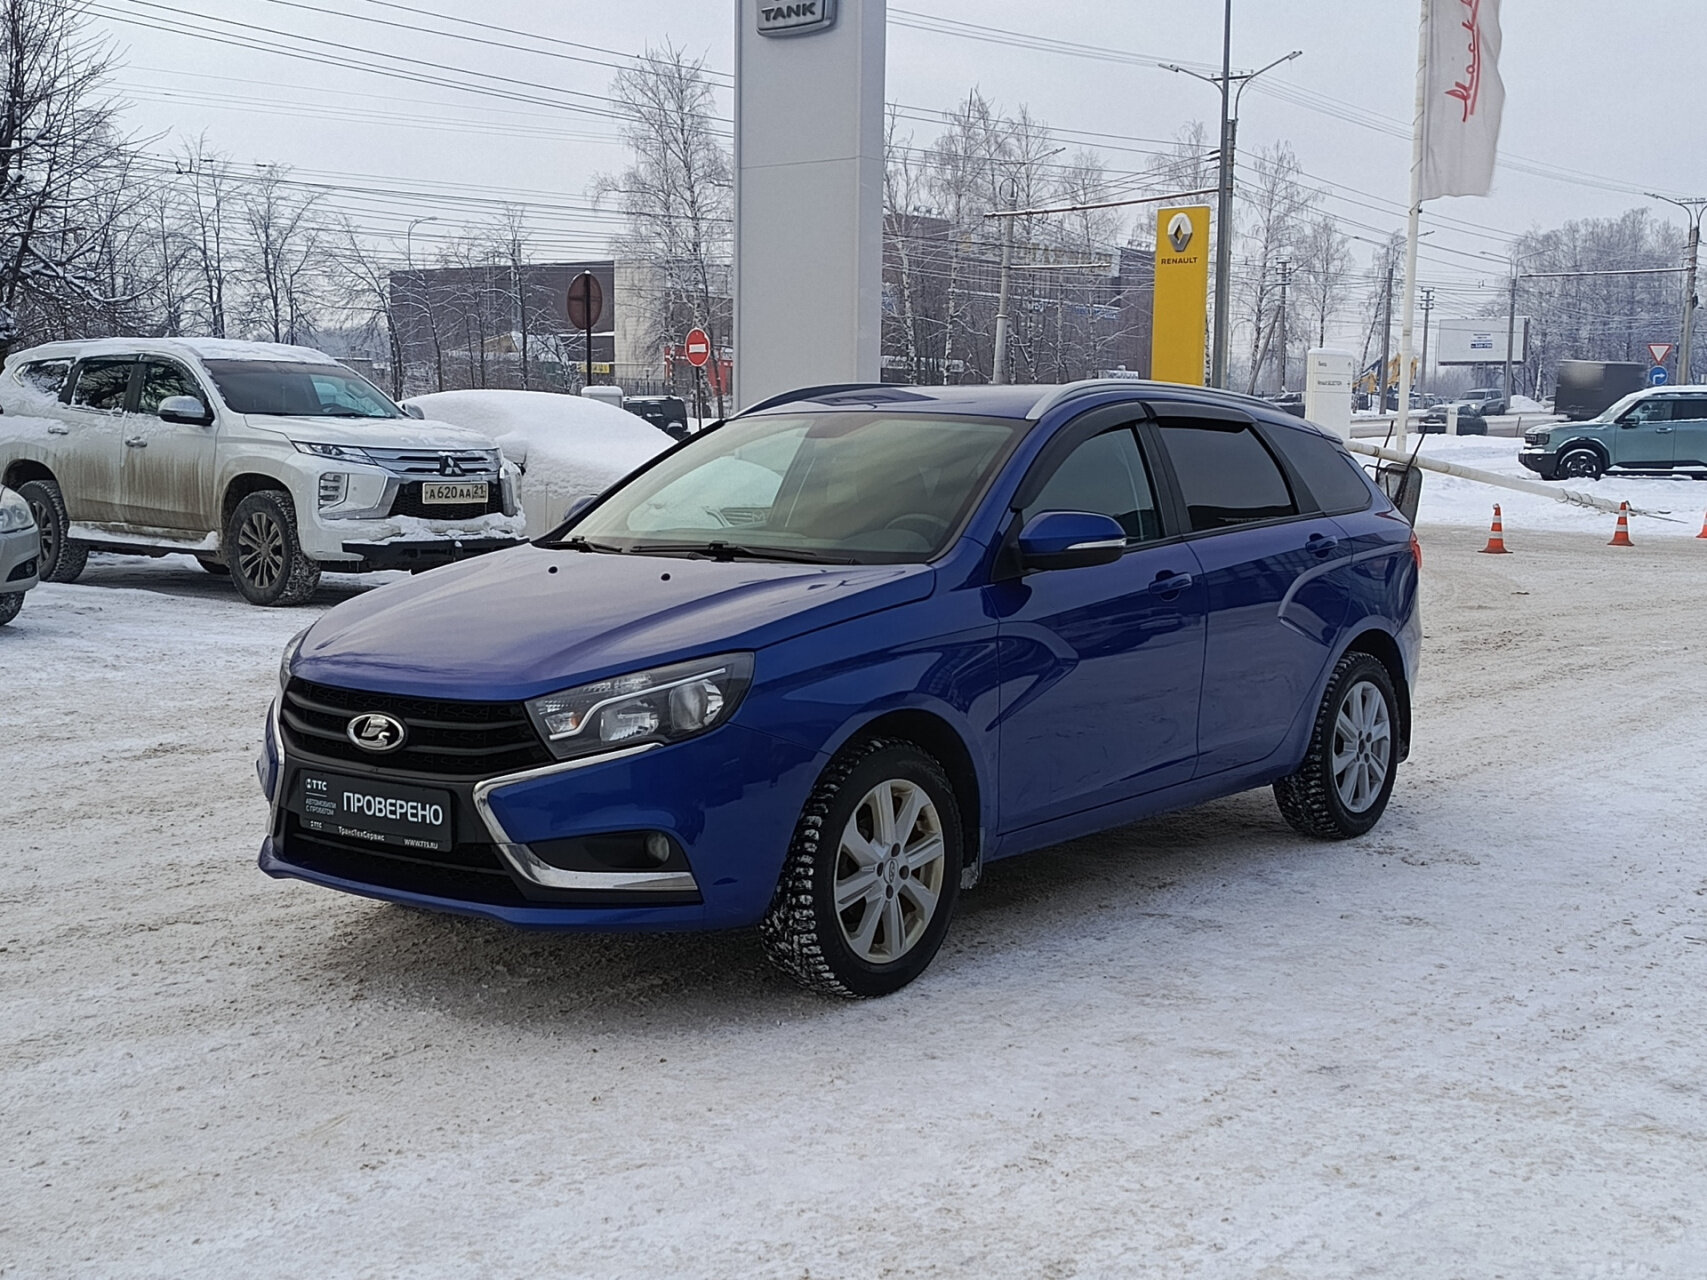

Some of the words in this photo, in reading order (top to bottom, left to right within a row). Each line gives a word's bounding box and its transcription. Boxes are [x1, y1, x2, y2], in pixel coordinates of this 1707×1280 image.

[761, 2, 816, 22] TANK
[1160, 256, 1198, 265] RENAULT
[343, 791, 443, 826] ПРОВЕРЕНО
